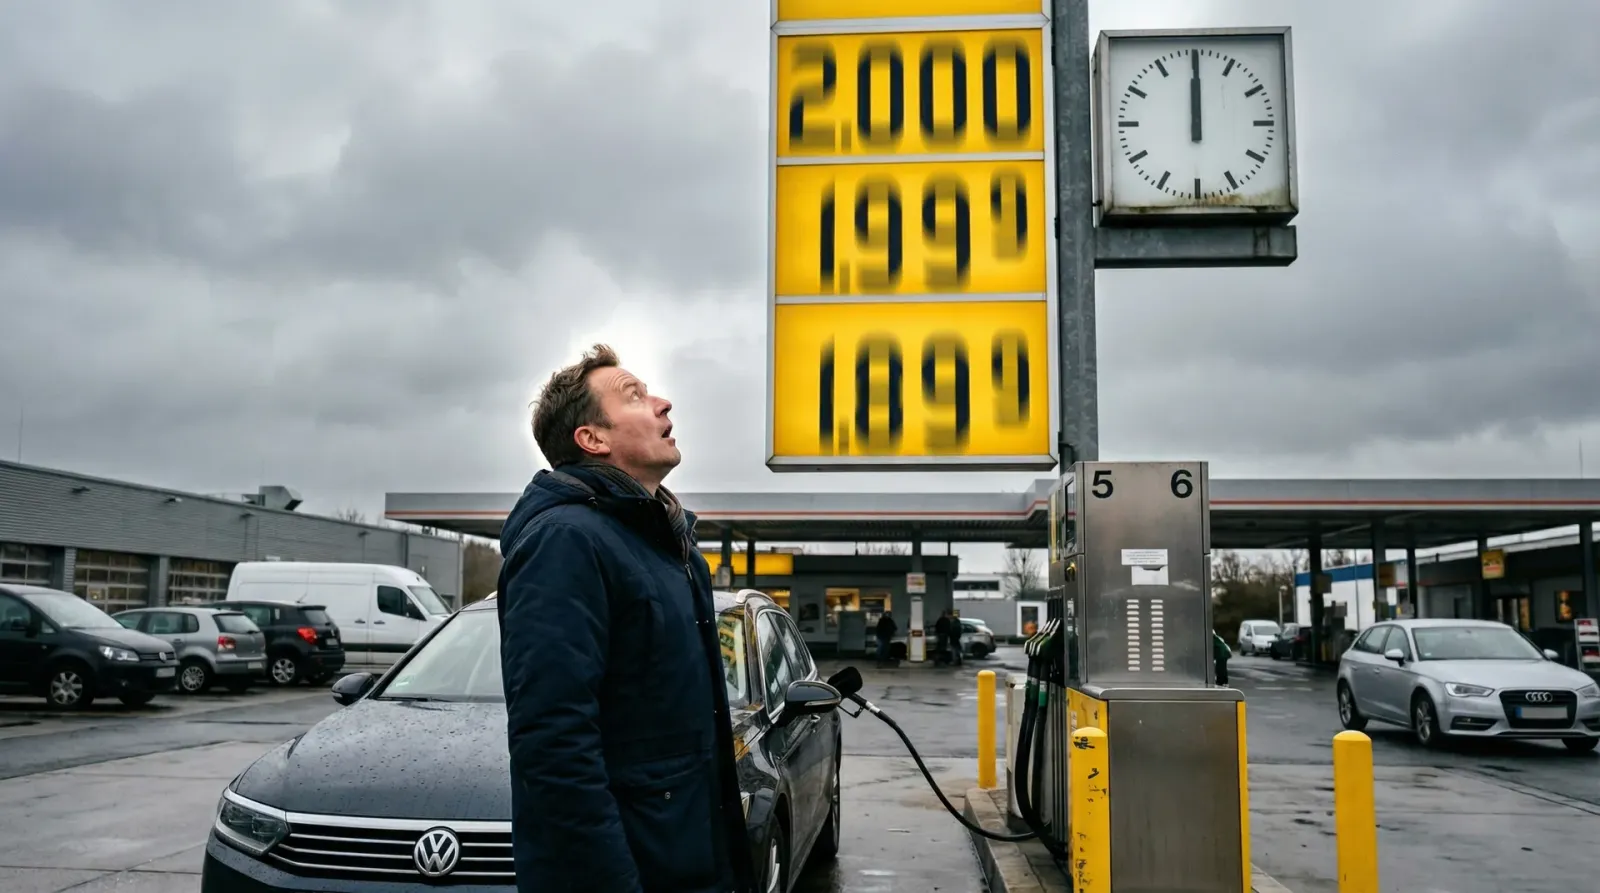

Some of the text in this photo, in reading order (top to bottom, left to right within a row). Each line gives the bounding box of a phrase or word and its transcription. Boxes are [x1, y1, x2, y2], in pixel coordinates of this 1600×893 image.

[789, 39, 1030, 151] 2.000
[1092, 470, 1113, 498] 5
[1170, 469, 1193, 498] 6
[415, 829, 459, 876] VW
